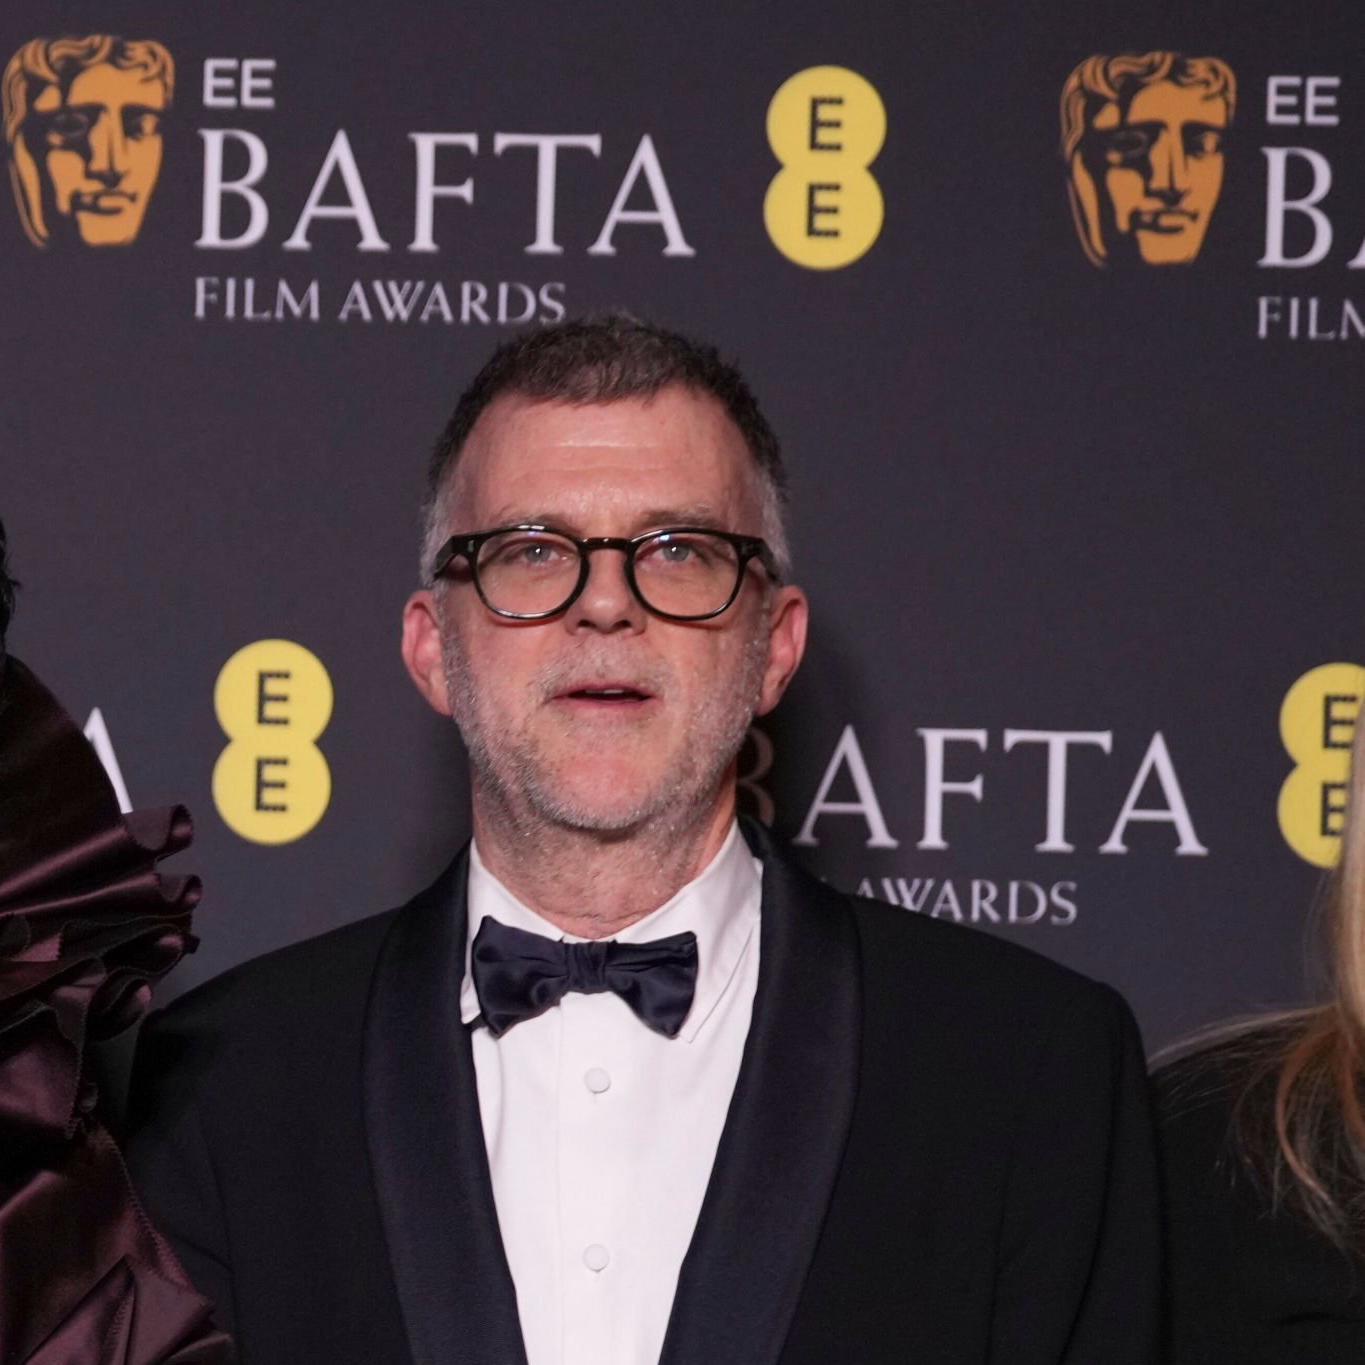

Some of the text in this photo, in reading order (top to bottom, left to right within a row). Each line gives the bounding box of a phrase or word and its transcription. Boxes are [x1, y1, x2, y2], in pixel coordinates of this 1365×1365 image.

[204, 59, 275, 107] EE
[1267, 76, 1340, 125] EE
[195, 129, 695, 256] BAFTA
[196, 277, 564, 323] FILM AWARDS
